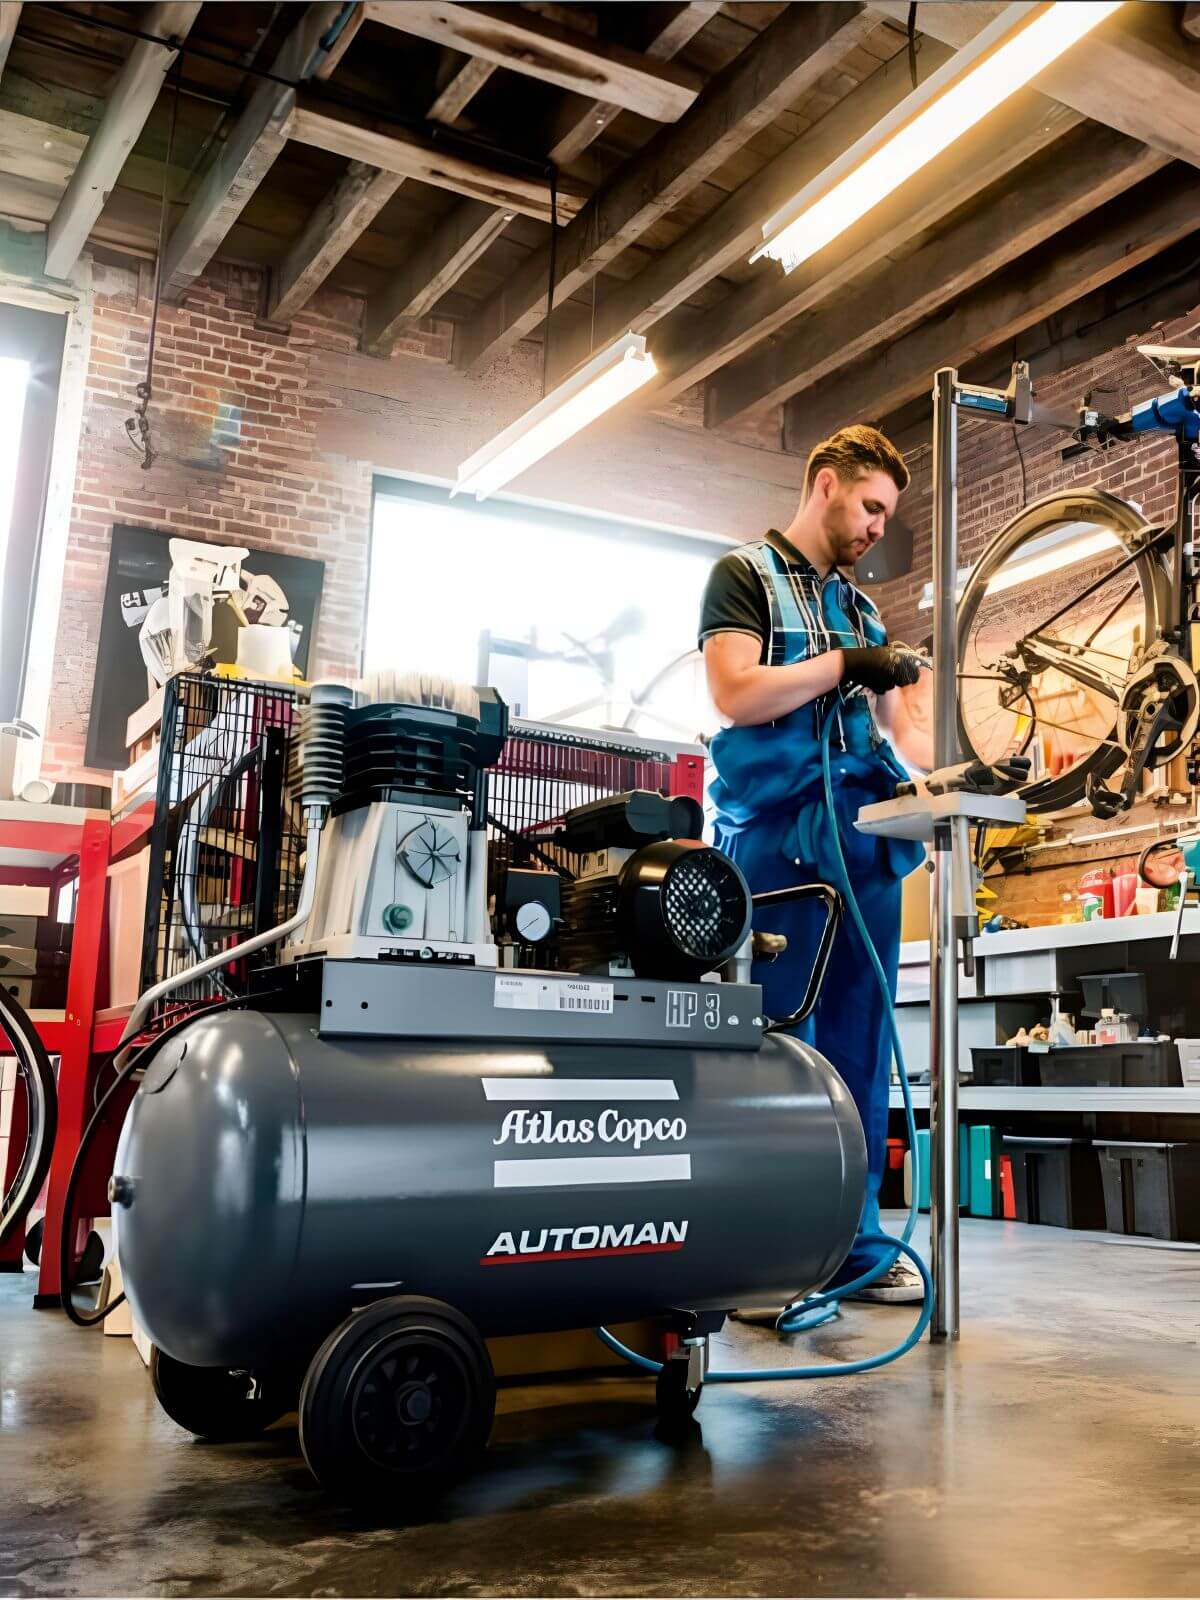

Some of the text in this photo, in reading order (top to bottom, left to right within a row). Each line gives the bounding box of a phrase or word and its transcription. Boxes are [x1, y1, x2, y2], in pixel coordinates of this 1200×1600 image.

[666, 990, 720, 1030] HP 3
[493, 1109, 687, 1149] Atlas Copco
[486, 1220, 688, 1256] AUTOMAN
